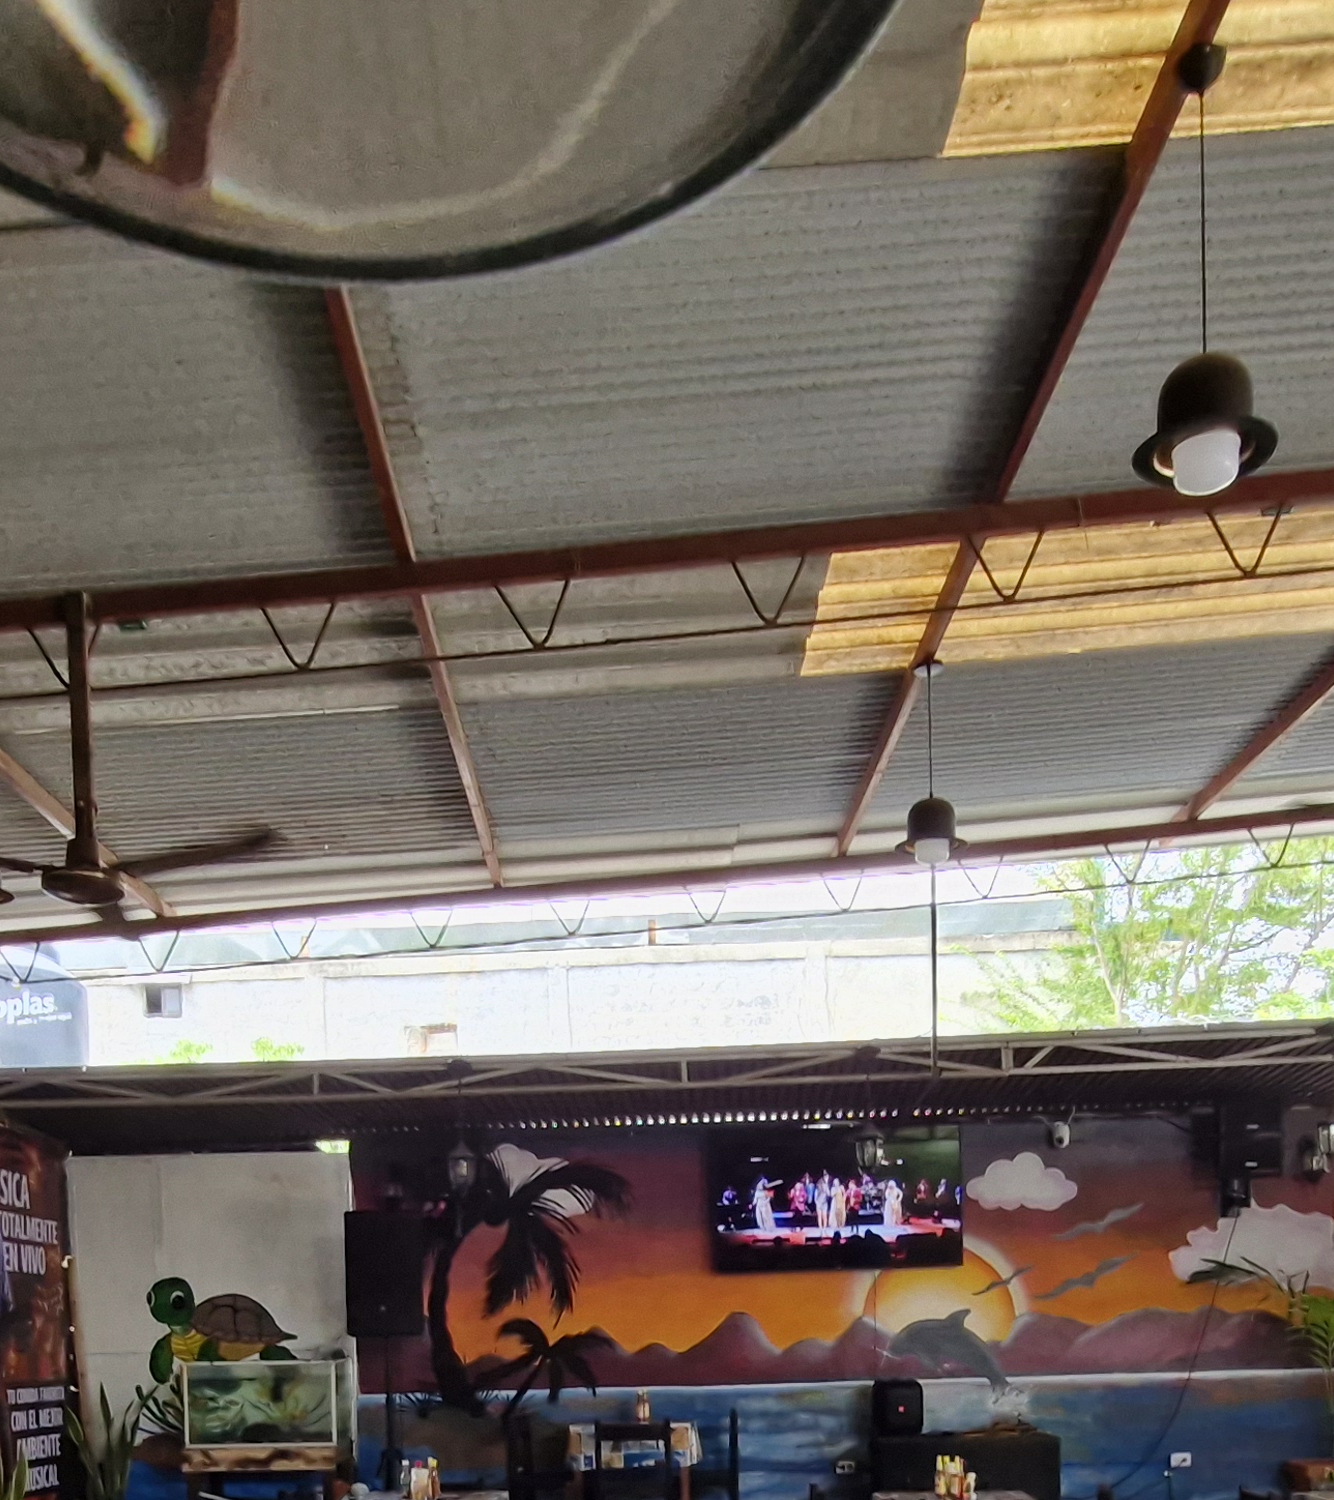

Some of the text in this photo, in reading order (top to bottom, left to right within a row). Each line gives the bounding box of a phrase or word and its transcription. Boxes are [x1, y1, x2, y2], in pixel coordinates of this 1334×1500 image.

[3, 1241, 47, 1276] EN VIVO
[11, 1410, 28, 1432] CON
[28, 1408, 38, 1430] EL
